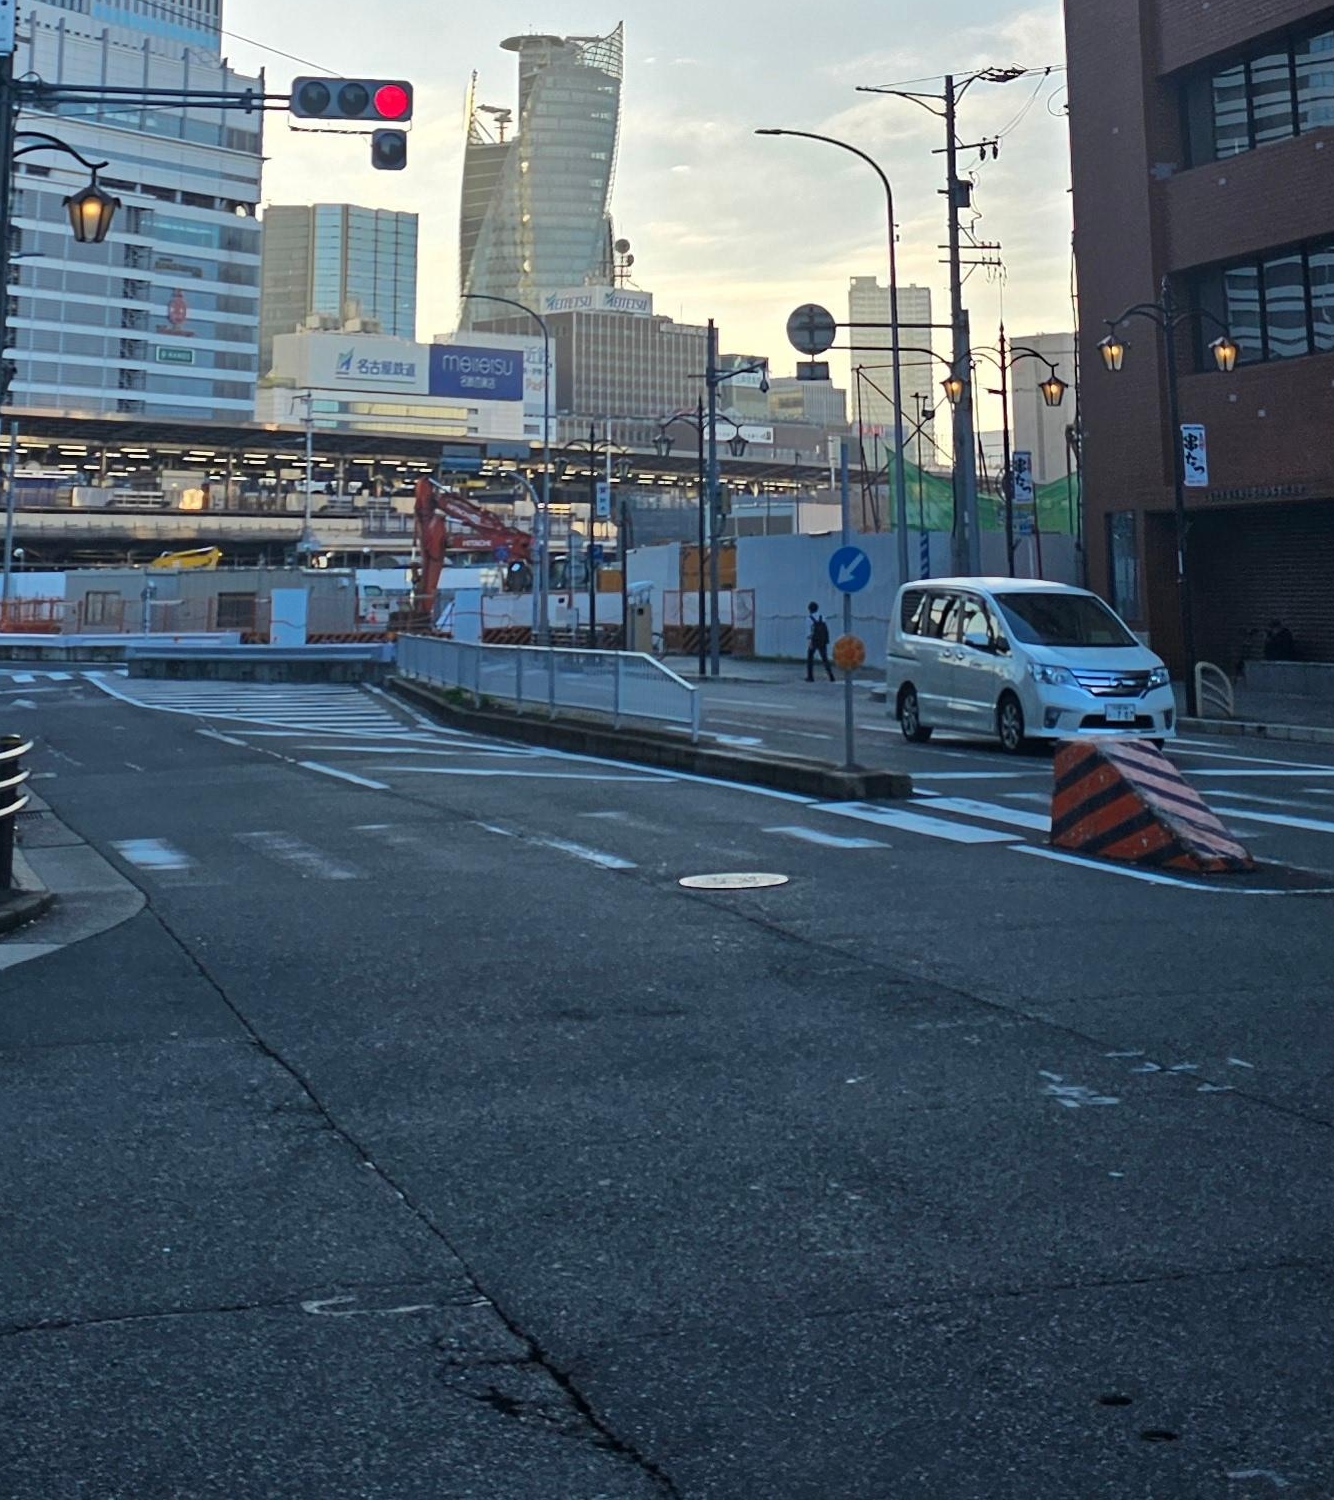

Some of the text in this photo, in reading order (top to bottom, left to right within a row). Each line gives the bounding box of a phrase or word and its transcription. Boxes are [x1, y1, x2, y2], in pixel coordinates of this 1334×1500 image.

[357, 357, 415, 377] 名古屋鉄道
